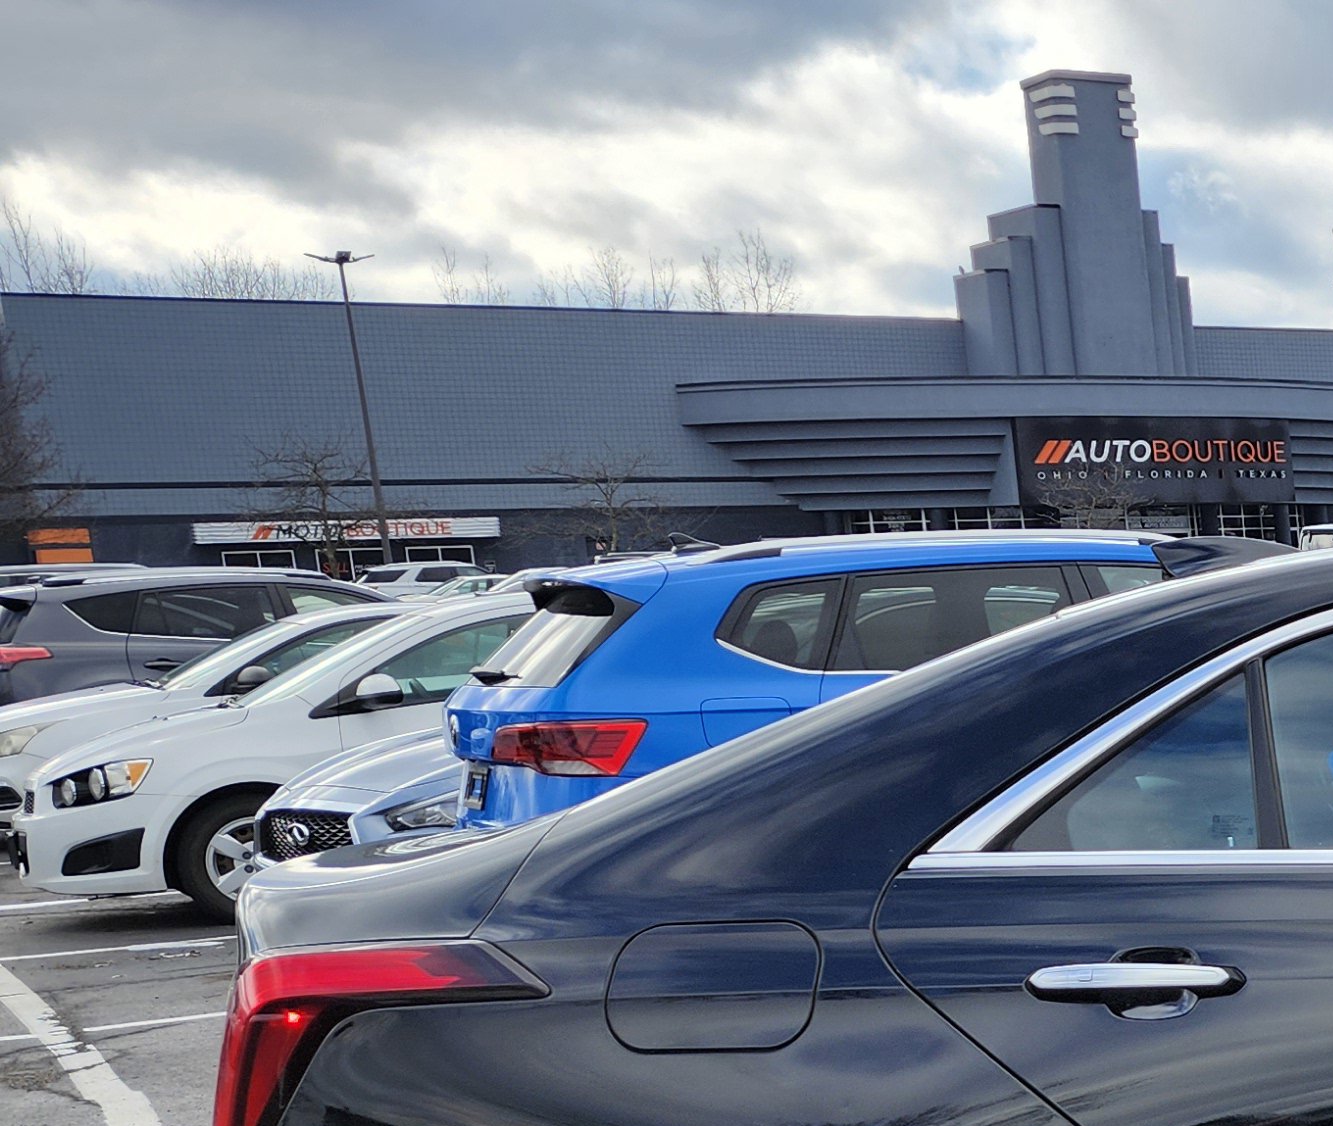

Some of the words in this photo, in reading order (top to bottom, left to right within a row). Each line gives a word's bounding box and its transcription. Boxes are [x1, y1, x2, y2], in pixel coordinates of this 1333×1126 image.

[1037, 470, 1088, 480] OHIO
[1124, 470, 1208, 479] FLORIDA
[1238, 469, 1287, 479] TEXAS
[322, 562, 349, 574] SLL
